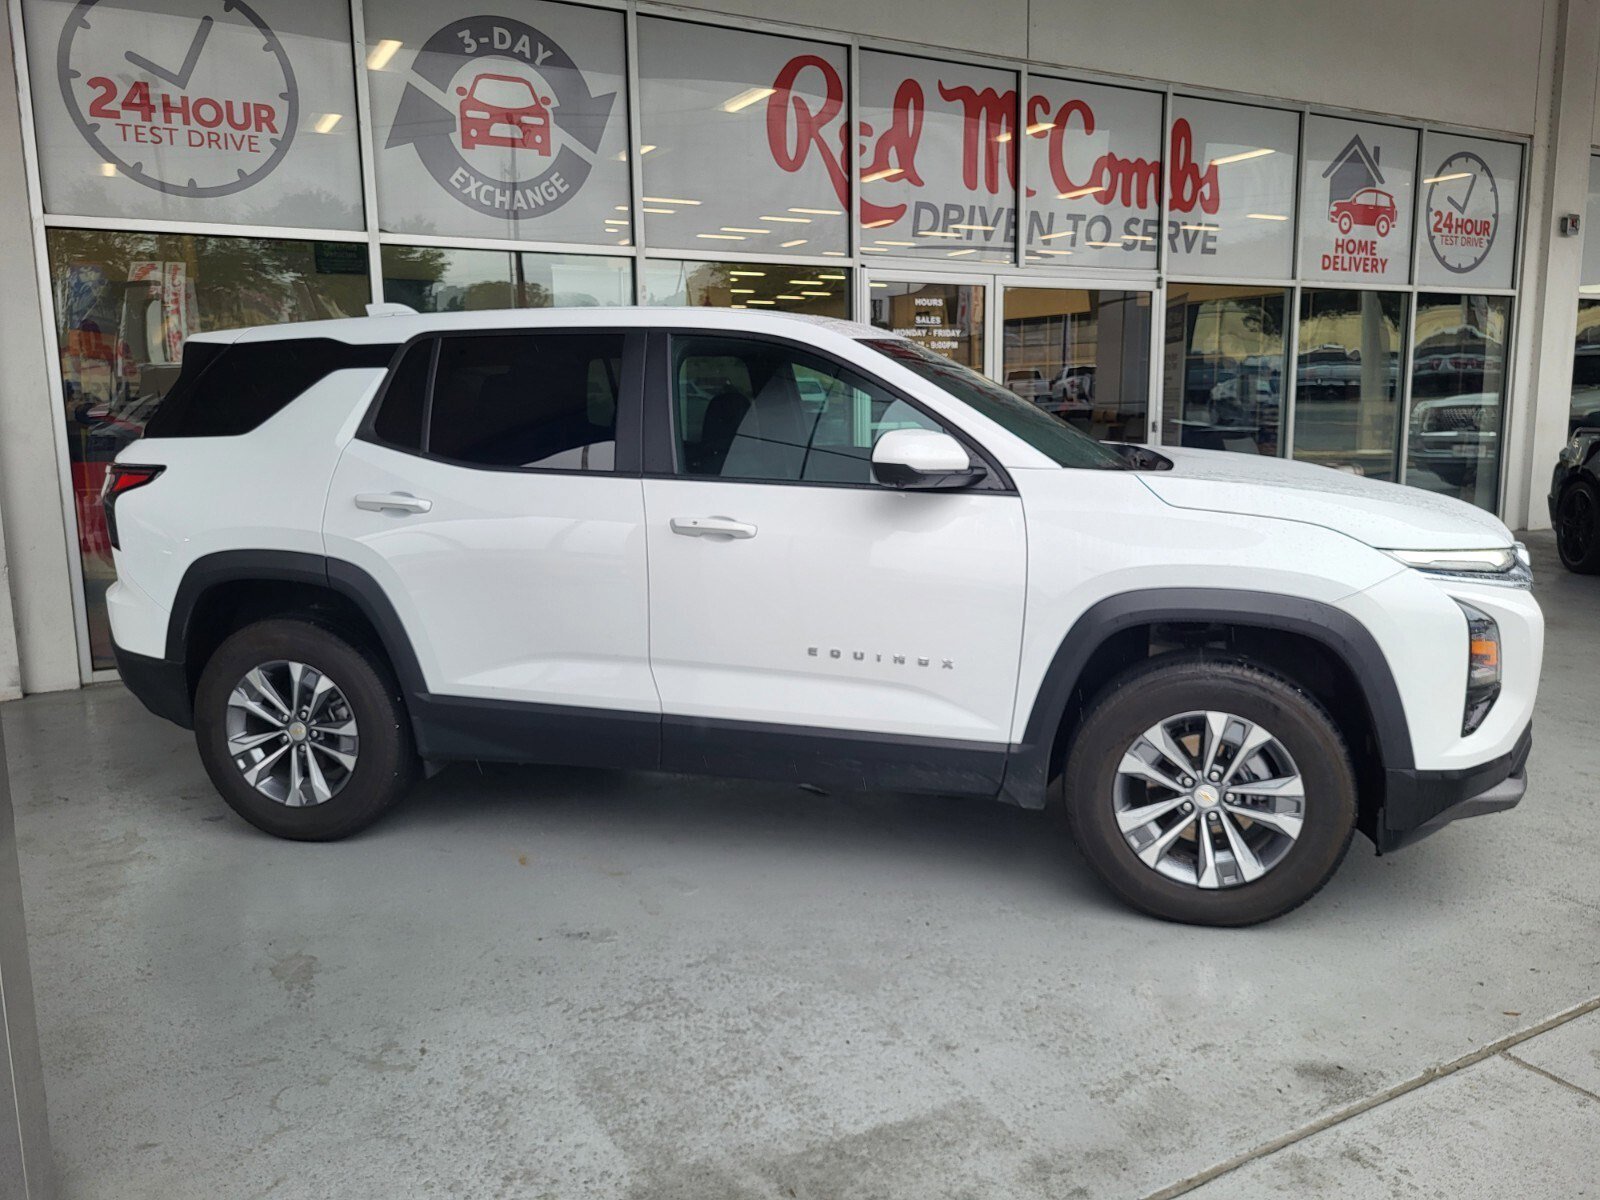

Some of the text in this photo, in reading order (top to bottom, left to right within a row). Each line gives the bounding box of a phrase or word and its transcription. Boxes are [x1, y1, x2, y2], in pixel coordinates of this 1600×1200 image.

[457, 26, 554, 67] 3-DAY
[86, 76, 279, 135] 24 HOUR
[115, 122, 261, 154] TEST DRIVE
[767, 55, 1221, 229] Red McCombs
[449, 166, 570, 211] EXCHANGE
[911, 200, 1220, 256] DRIVEN TO SERVE
[1432, 210, 1491, 237] 24 HOUR
[1334, 238, 1377, 257] HOME
[1440, 234, 1485, 248] TEST DRIVE
[1321, 254, 1389, 274] DELIVERY
[914, 298, 944, 307] HOURS
[915, 315, 942, 325] SALES
[932, 328, 962, 338] FRIDAY
[807, 646, 954, 670] EQUINOX
